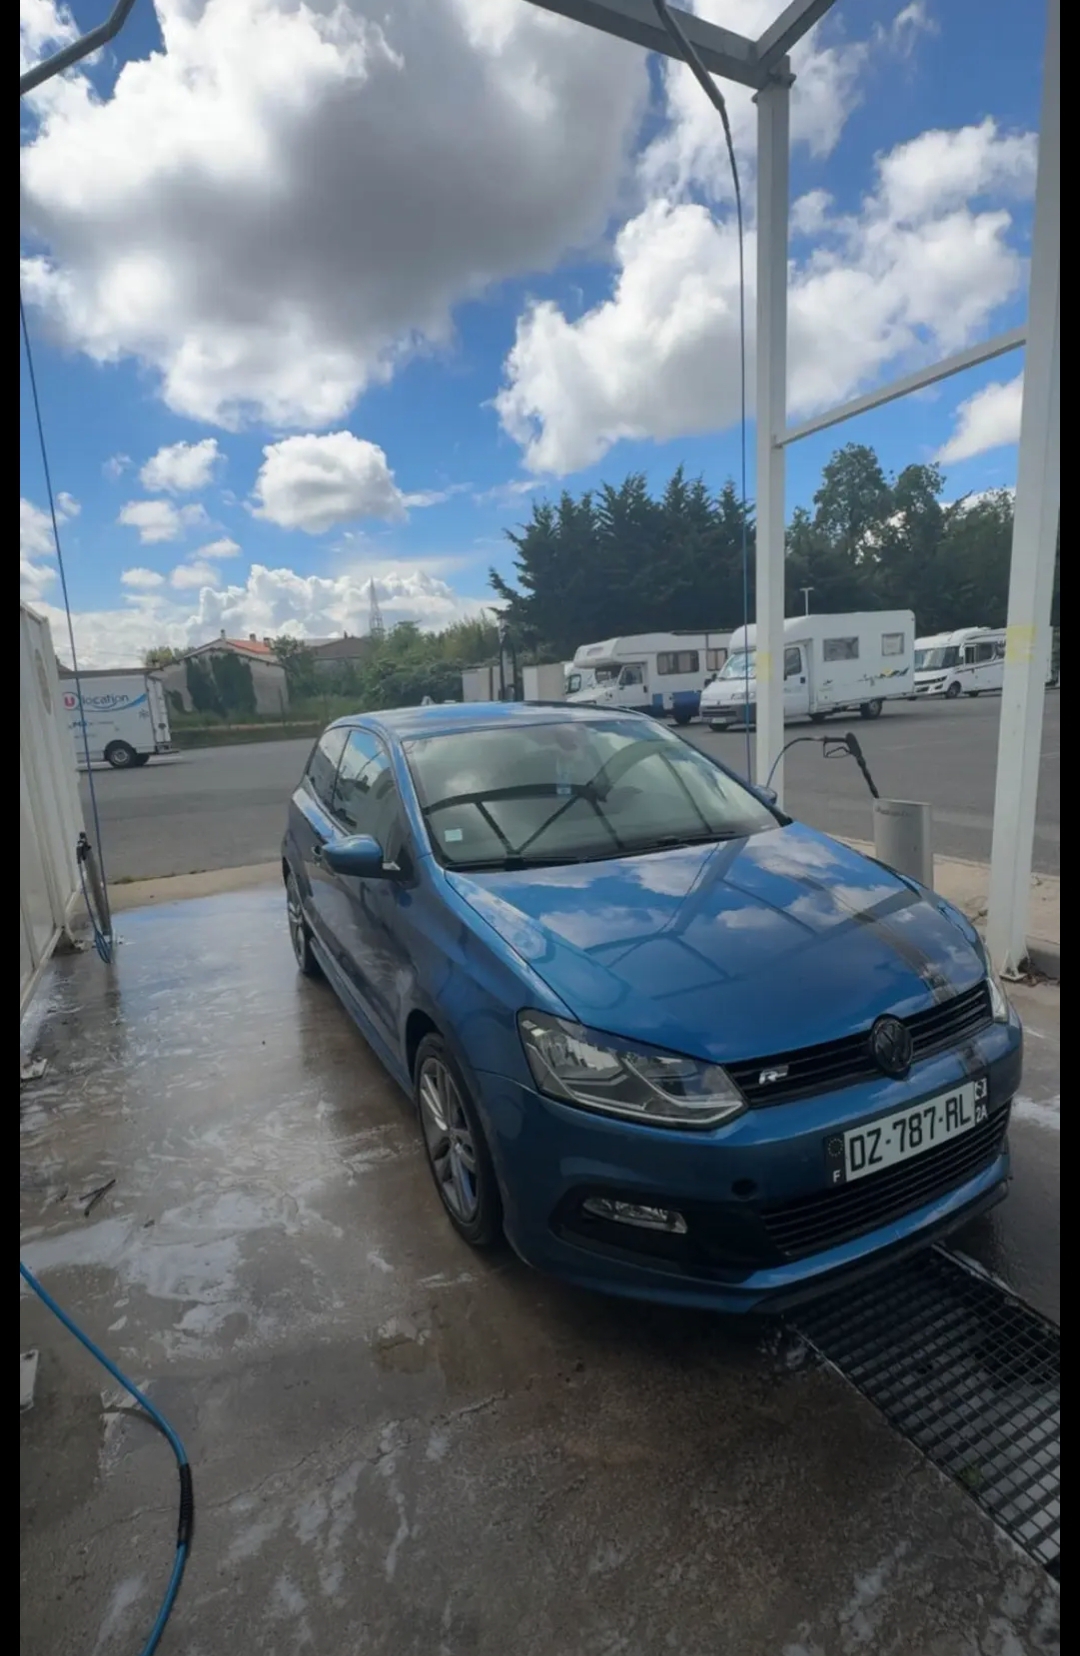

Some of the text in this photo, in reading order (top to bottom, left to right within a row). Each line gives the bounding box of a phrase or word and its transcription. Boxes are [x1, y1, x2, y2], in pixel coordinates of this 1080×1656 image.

[82, 693, 129, 706] location
[975, 1104, 988, 1122] 2A
[833, 1170, 841, 1183] F
